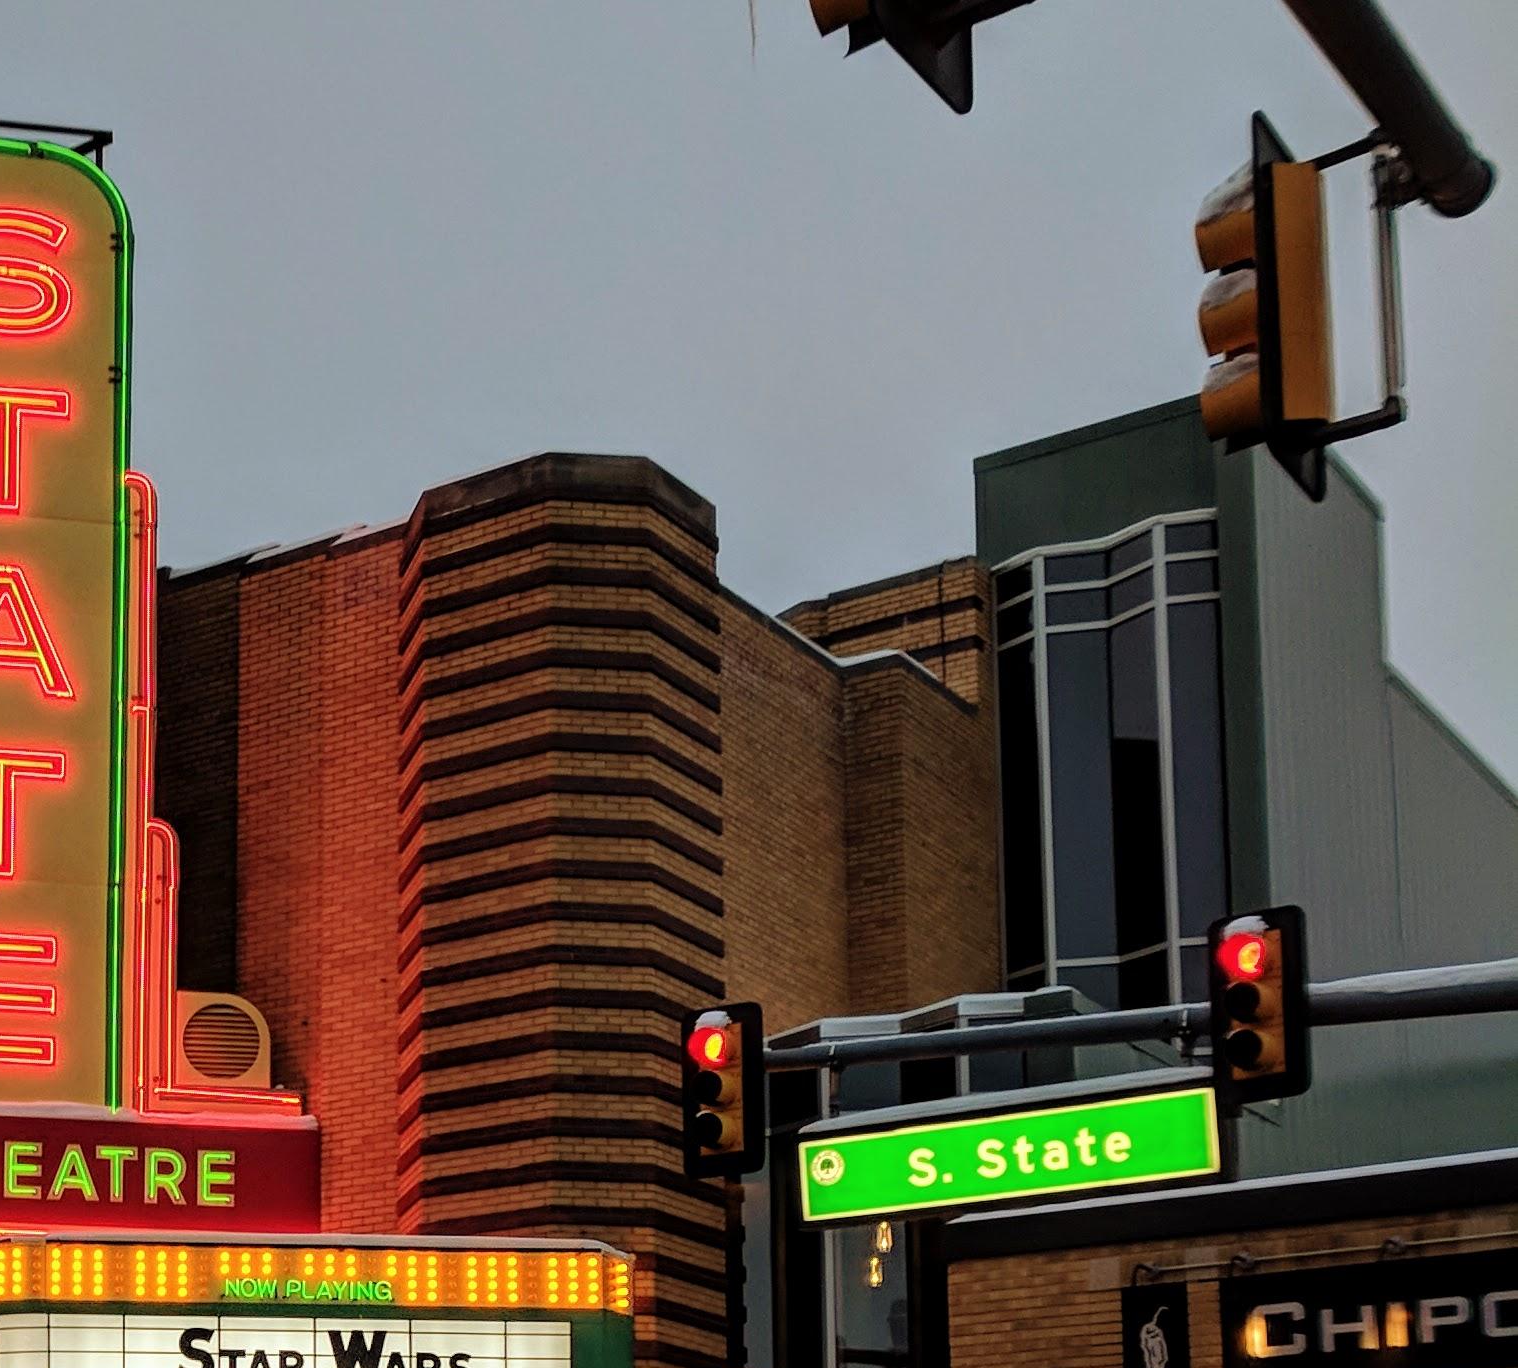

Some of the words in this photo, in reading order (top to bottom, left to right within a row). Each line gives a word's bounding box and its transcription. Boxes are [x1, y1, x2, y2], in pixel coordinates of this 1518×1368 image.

[907, 1147, 954, 1188] S.
[976, 1126, 1132, 1179] State
[225, 1277, 278, 1299] NOW
[286, 1279, 394, 1302] PLAYING
